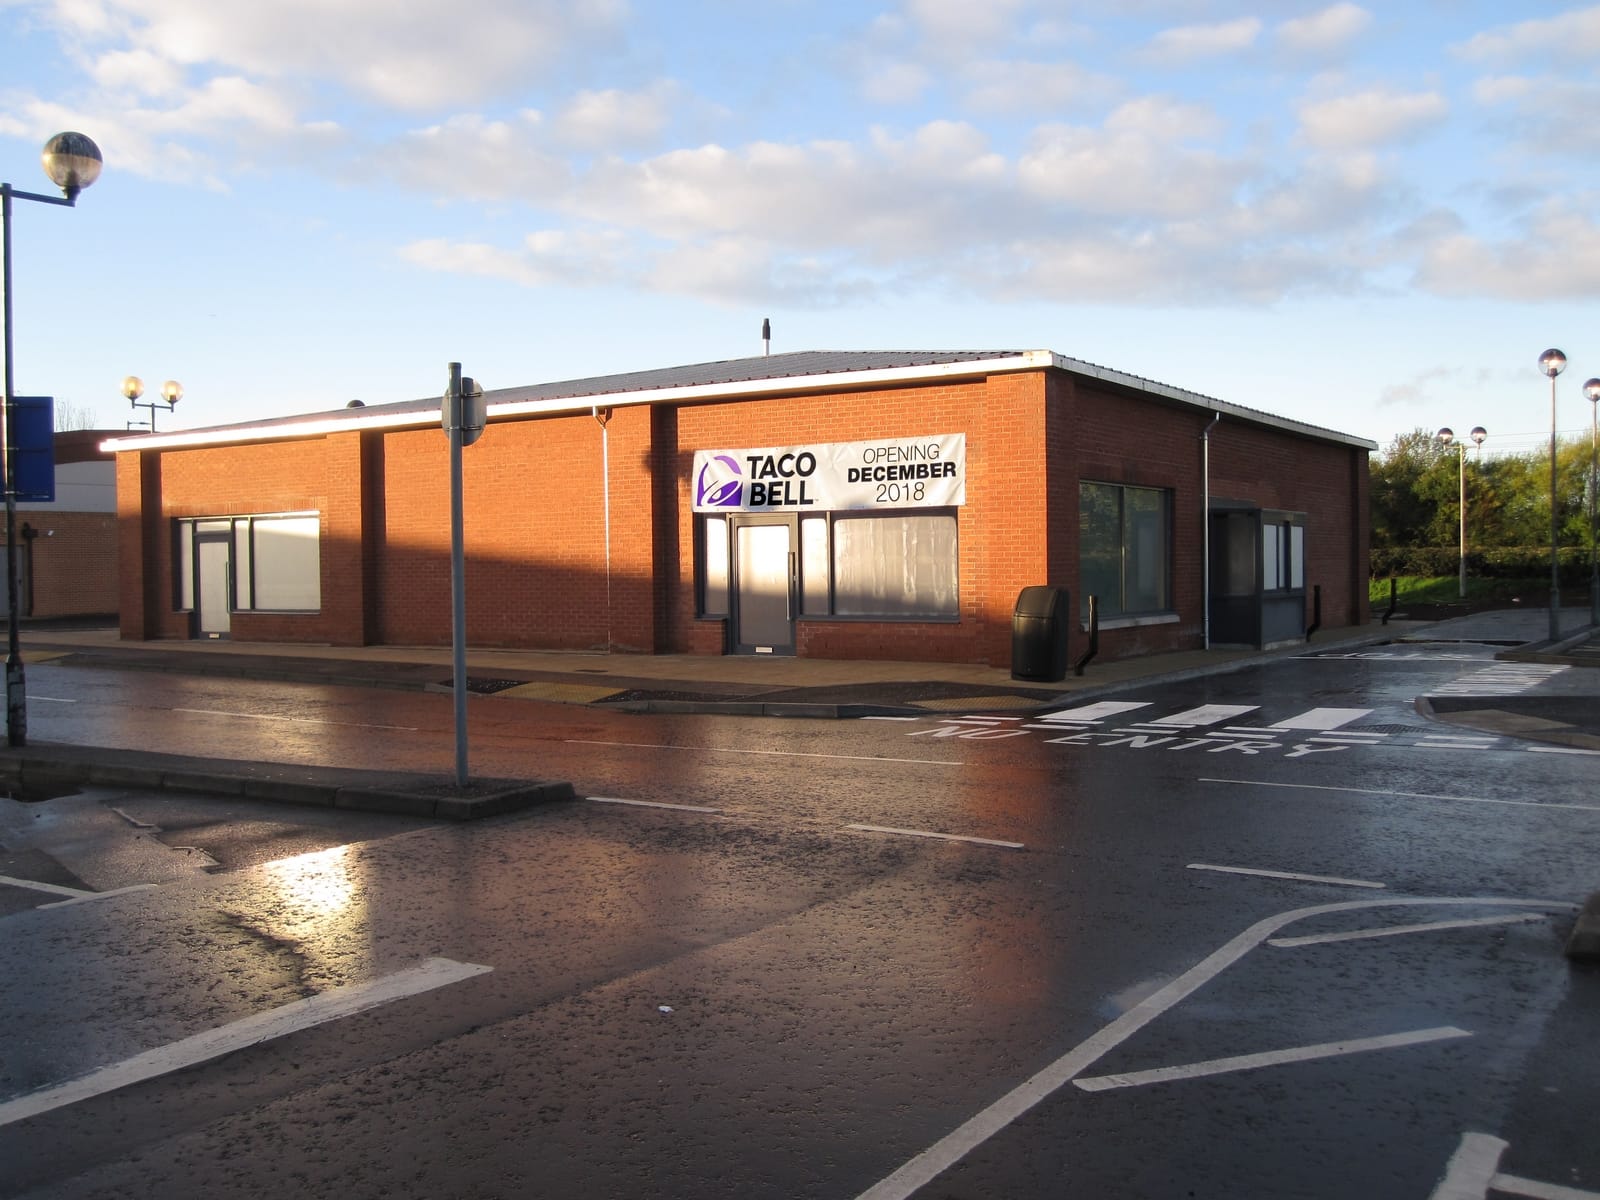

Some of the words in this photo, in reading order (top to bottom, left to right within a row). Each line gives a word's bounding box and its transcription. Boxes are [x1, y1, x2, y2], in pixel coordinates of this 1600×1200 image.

[863, 443, 941, 464] OPENING
[747, 452, 817, 480] TACO
[847, 461, 956, 483] DECEMBER
[749, 480, 814, 506] BELL
[876, 482, 925, 503] 2018
[904, 726, 1032, 740] NO
[1043, 732, 1350, 757] ENTRY
